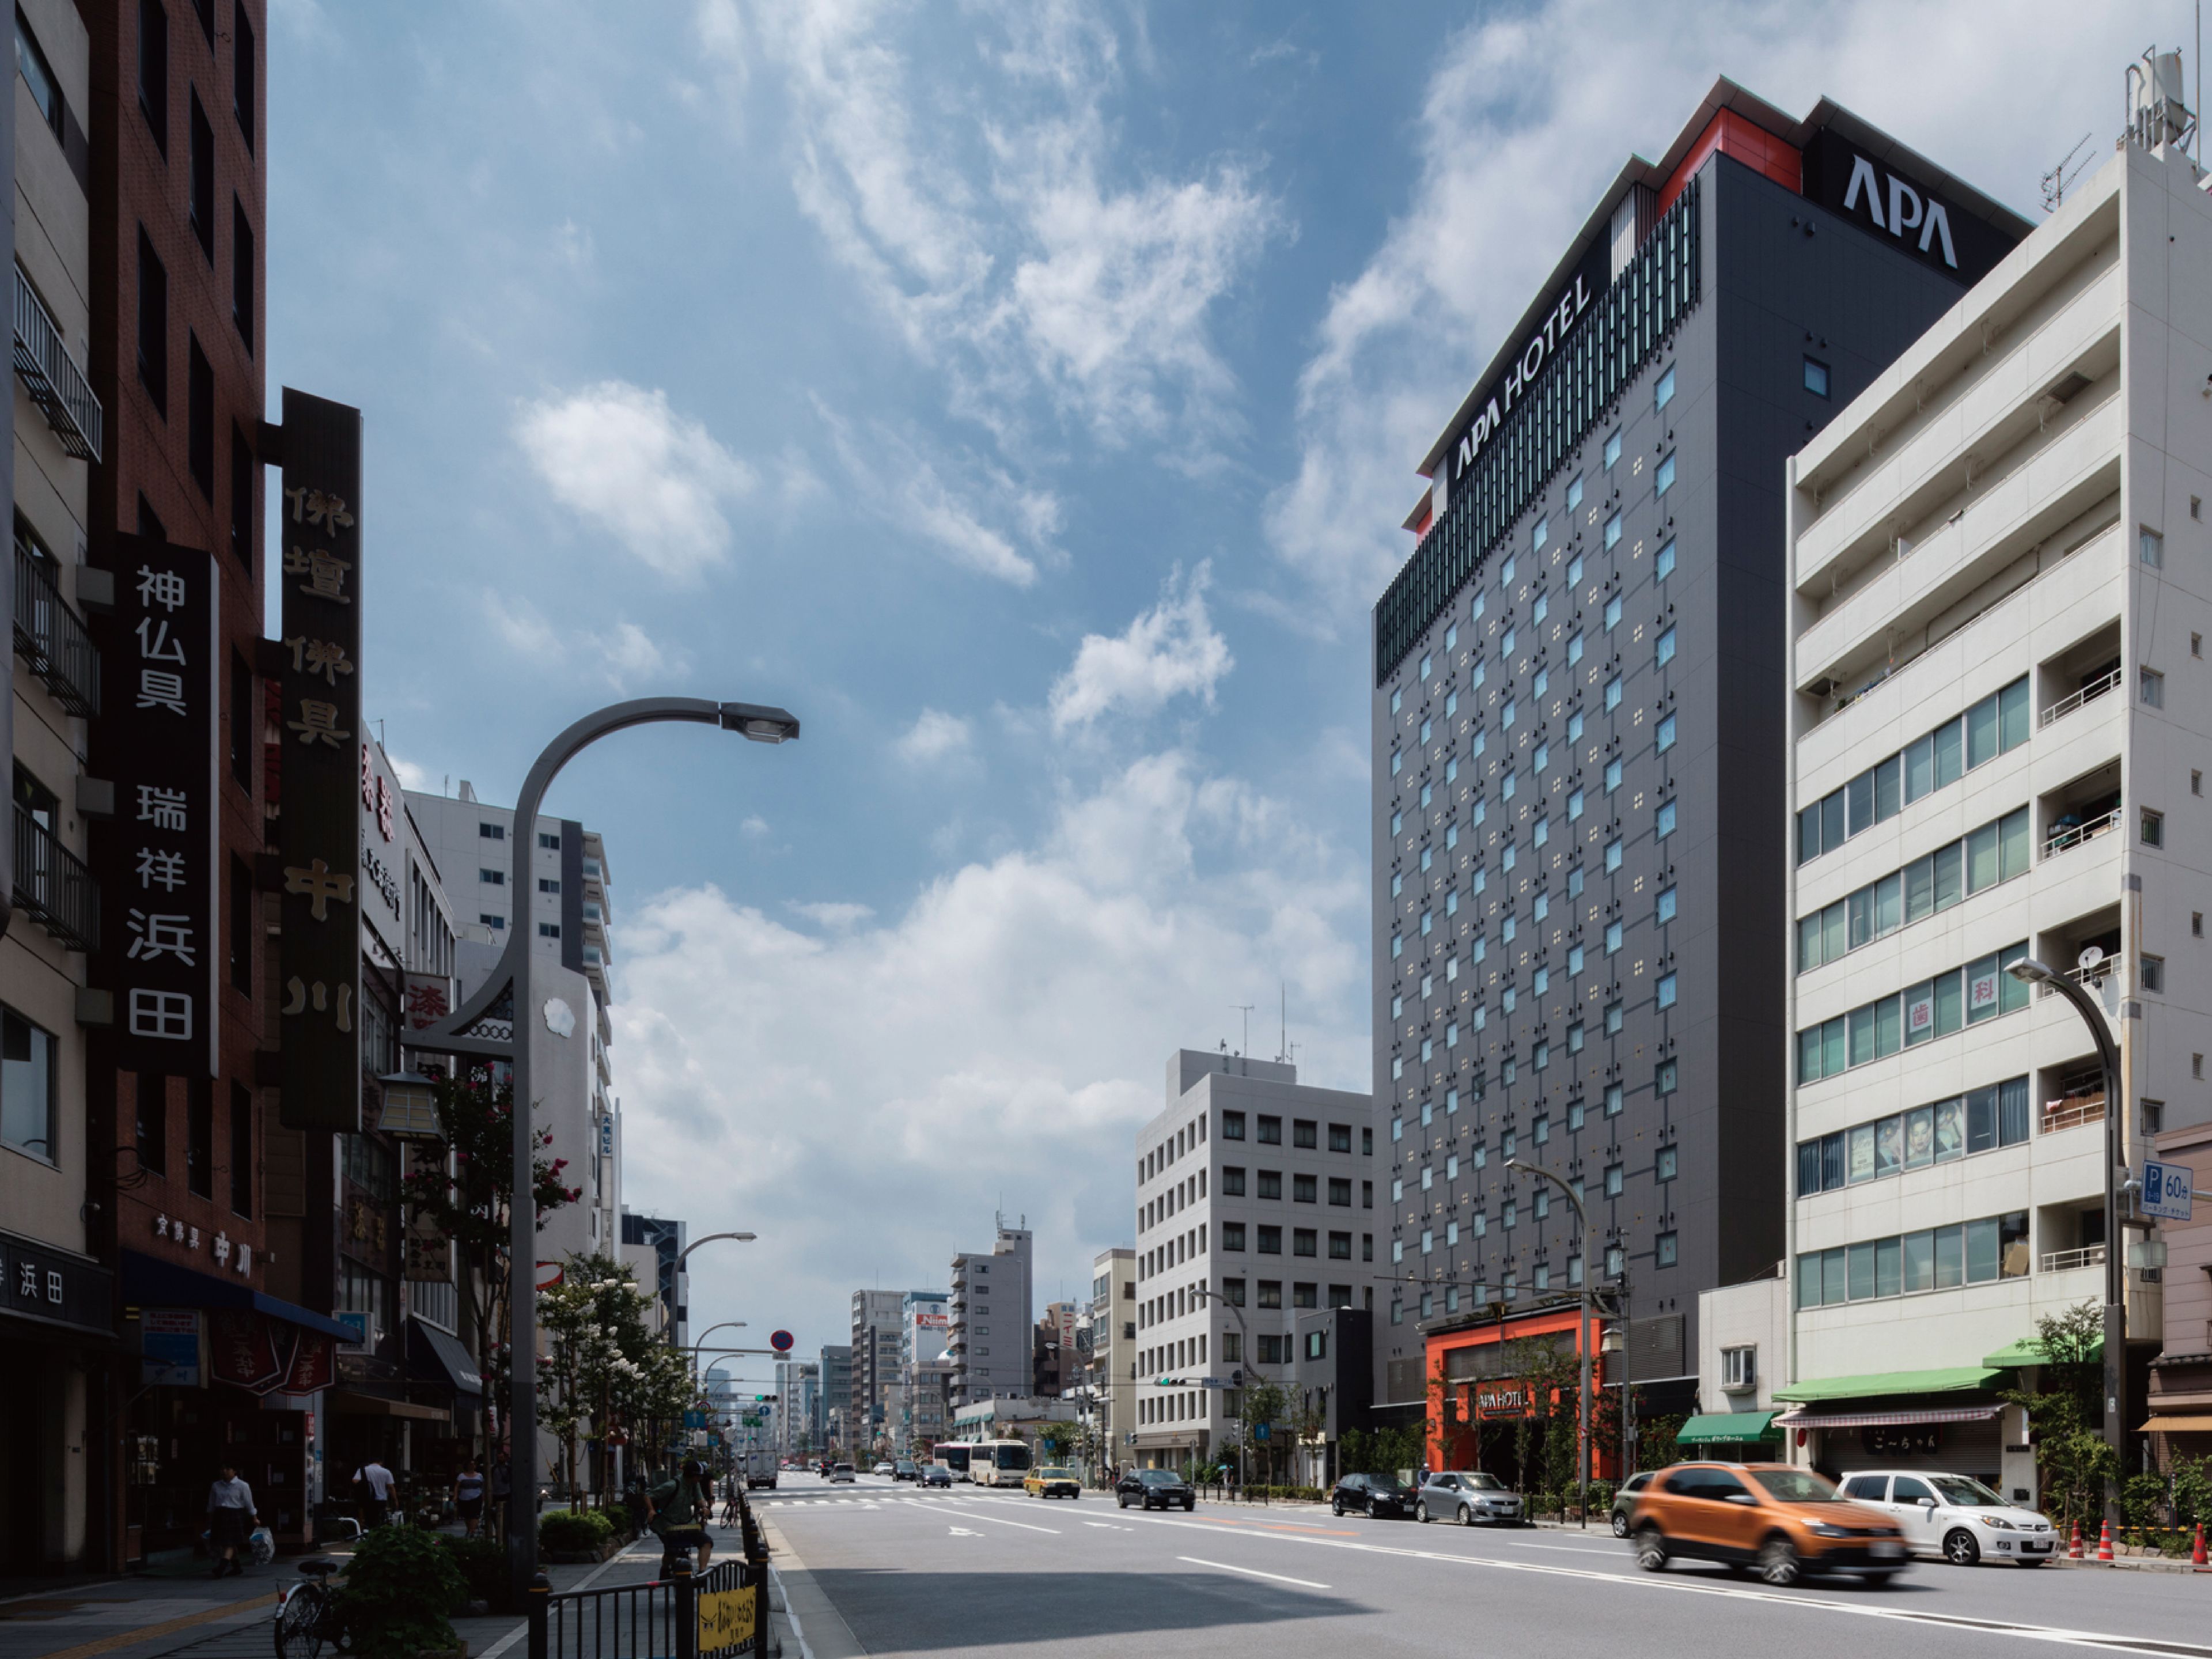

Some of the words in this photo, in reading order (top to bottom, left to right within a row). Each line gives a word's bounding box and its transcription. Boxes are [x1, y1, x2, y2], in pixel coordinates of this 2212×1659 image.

[1843, 153, 1958, 269] APA
[1456, 397, 1501, 479] APA
[1505, 274, 1591, 414] HOTEL
[136, 565, 187, 717] 神仏具
[285, 635, 354, 749] 佛具
[282, 858, 355, 1033] 中川
[2150, 1169, 2159, 1188] P
[2166, 1175, 2187, 1199] 60分
[214, 1230, 252, 1278] 中川
[1063, 1313, 1073, 1346] ニイミ
